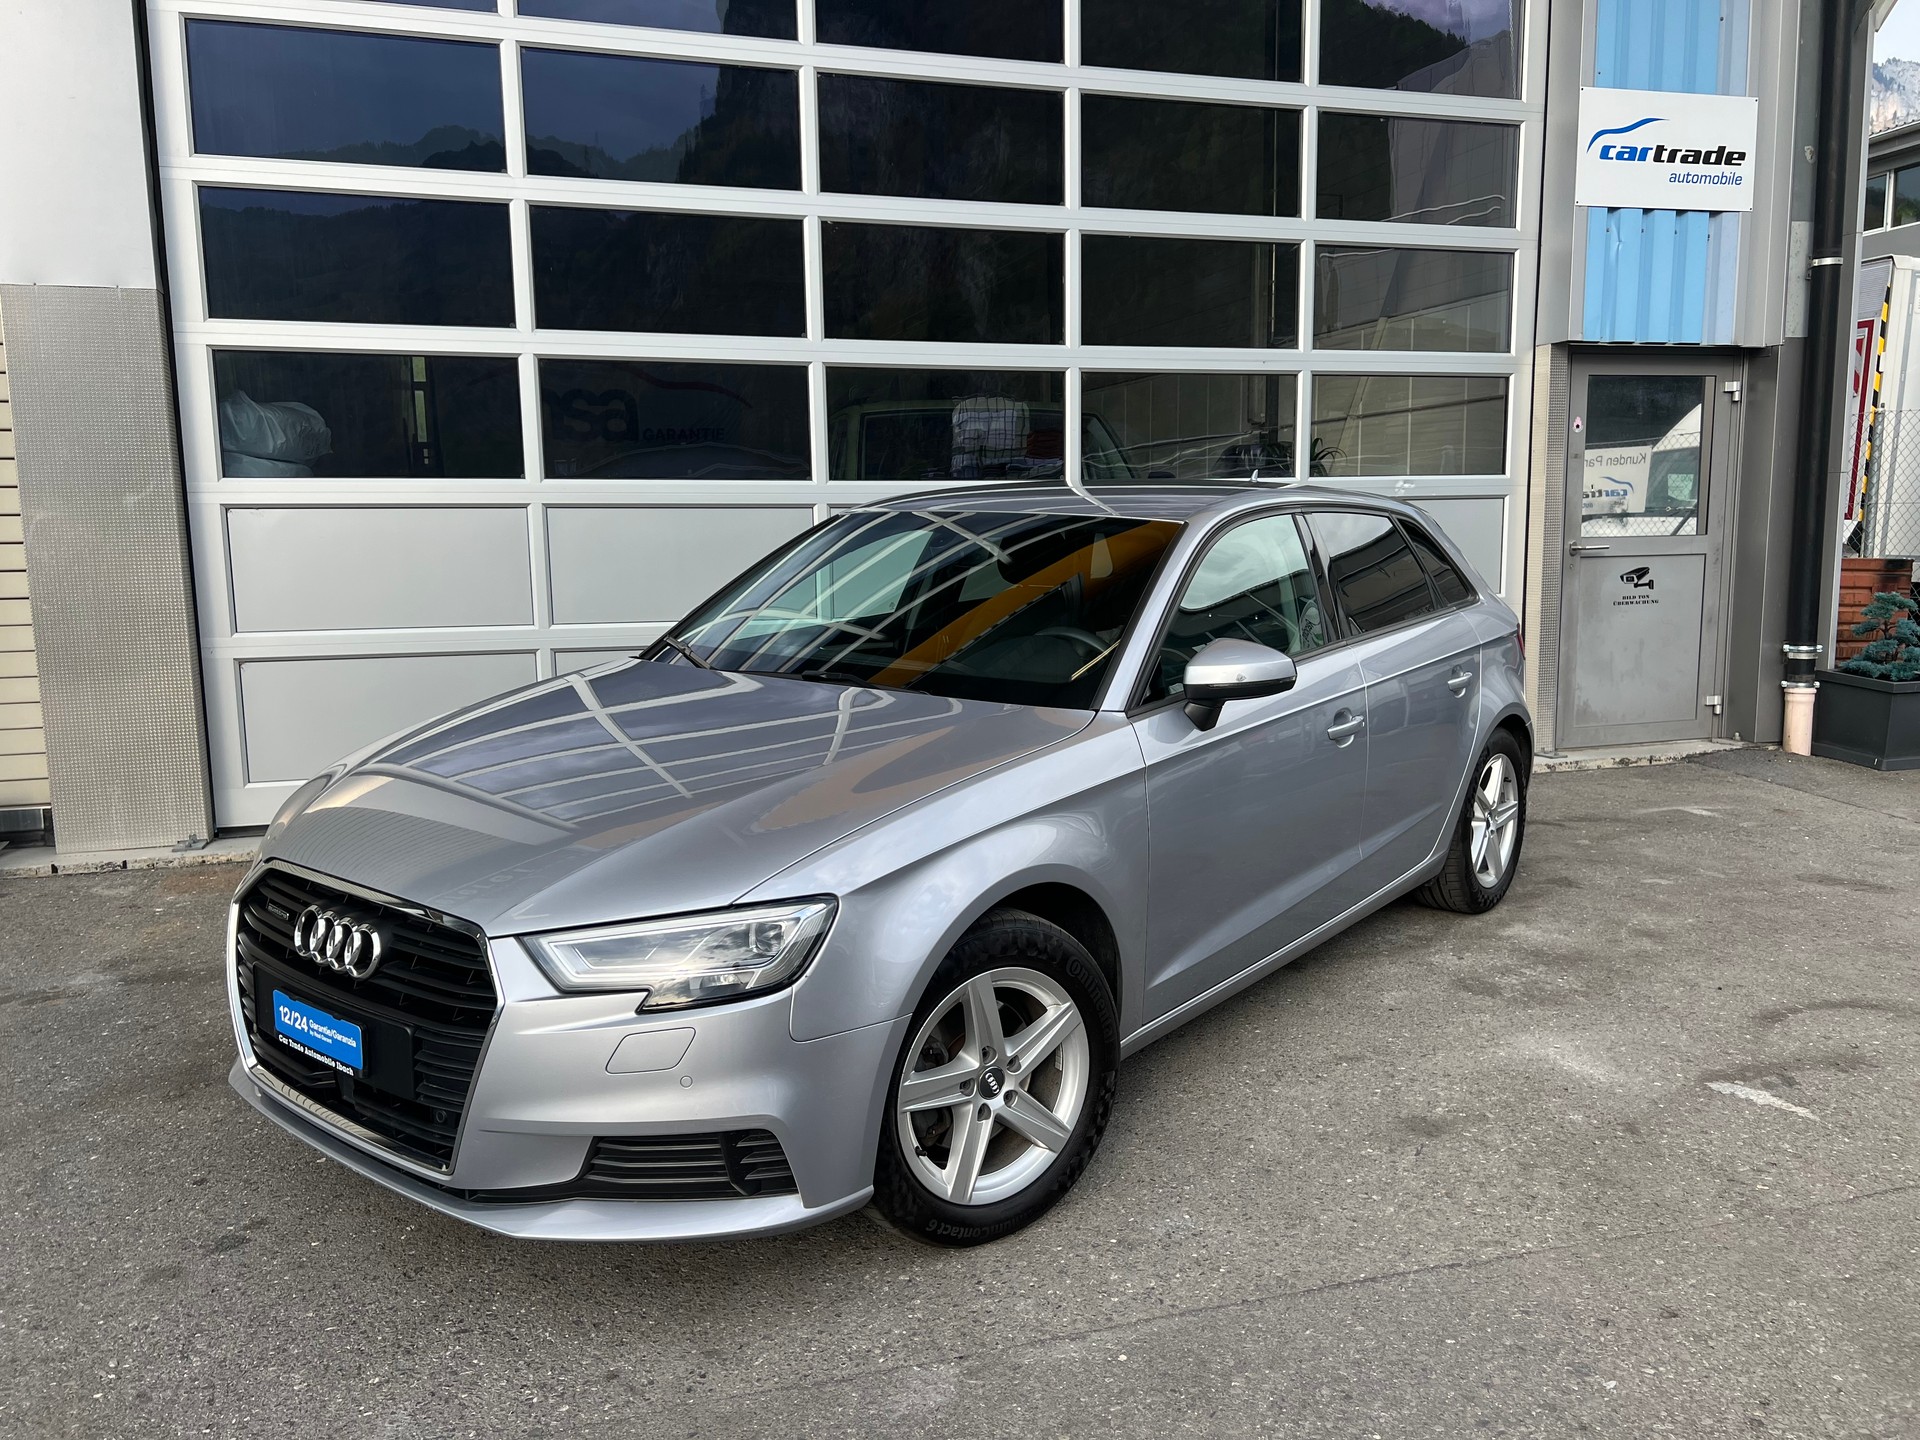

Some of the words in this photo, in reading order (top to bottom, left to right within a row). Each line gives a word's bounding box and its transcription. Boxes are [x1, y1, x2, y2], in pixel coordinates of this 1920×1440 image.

[1599, 144, 1747, 166] cartrade
[1669, 171, 1743, 186] automobile
[643, 427, 724, 442] GARANTIE
[279, 1005, 308, 1033] 12/24
[278, 1034, 289, 1045] Car
[289, 1039, 304, 1052] Trade
[304, 1046, 336, 1068] Automobile
[336, 1061, 354, 1076] Ibach
